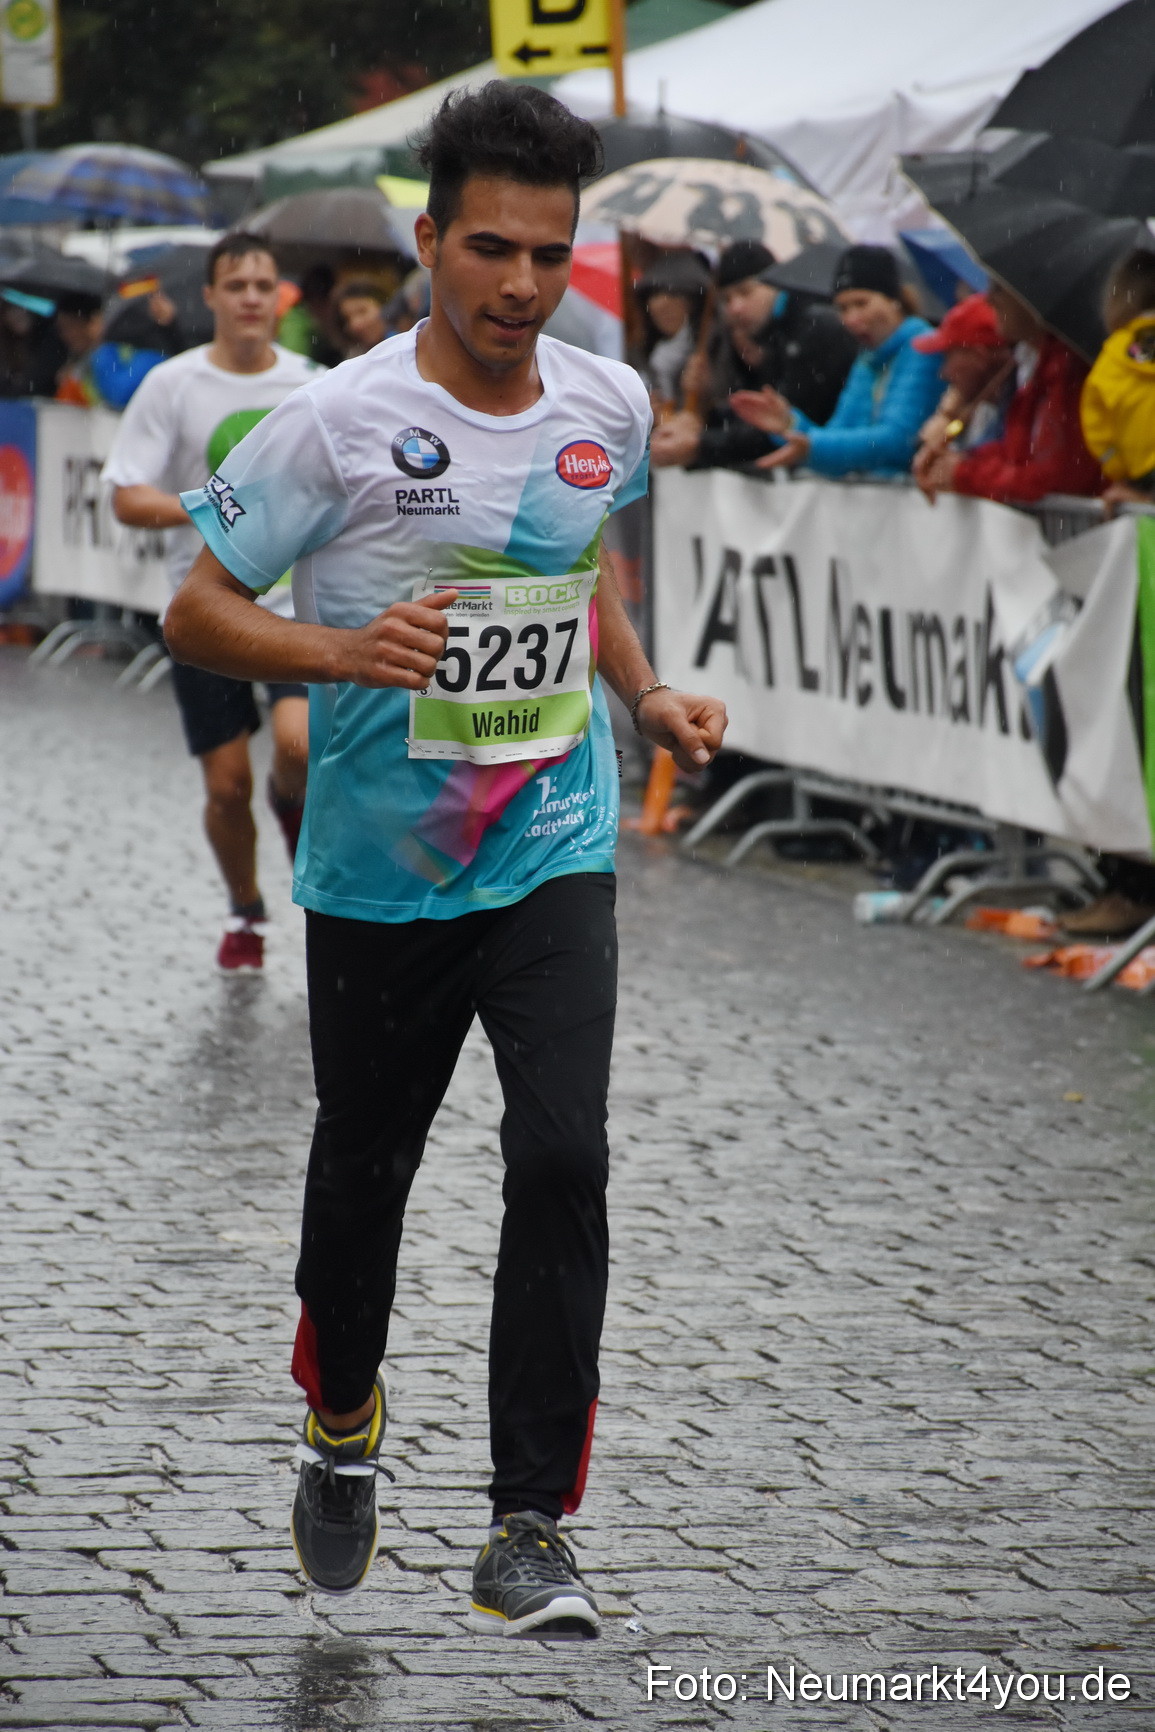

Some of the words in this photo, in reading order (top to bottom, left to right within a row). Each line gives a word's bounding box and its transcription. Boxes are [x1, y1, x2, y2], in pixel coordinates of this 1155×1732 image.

[395, 428, 442, 447] BMW
[564, 454, 610, 476] Hervis
[395, 488, 459, 504] PARTL
[397, 504, 460, 516] Neumarkt
[505, 579, 583, 607] BOCK
[435, 617, 579, 693] 5237
[472, 707, 540, 738] Wahid
